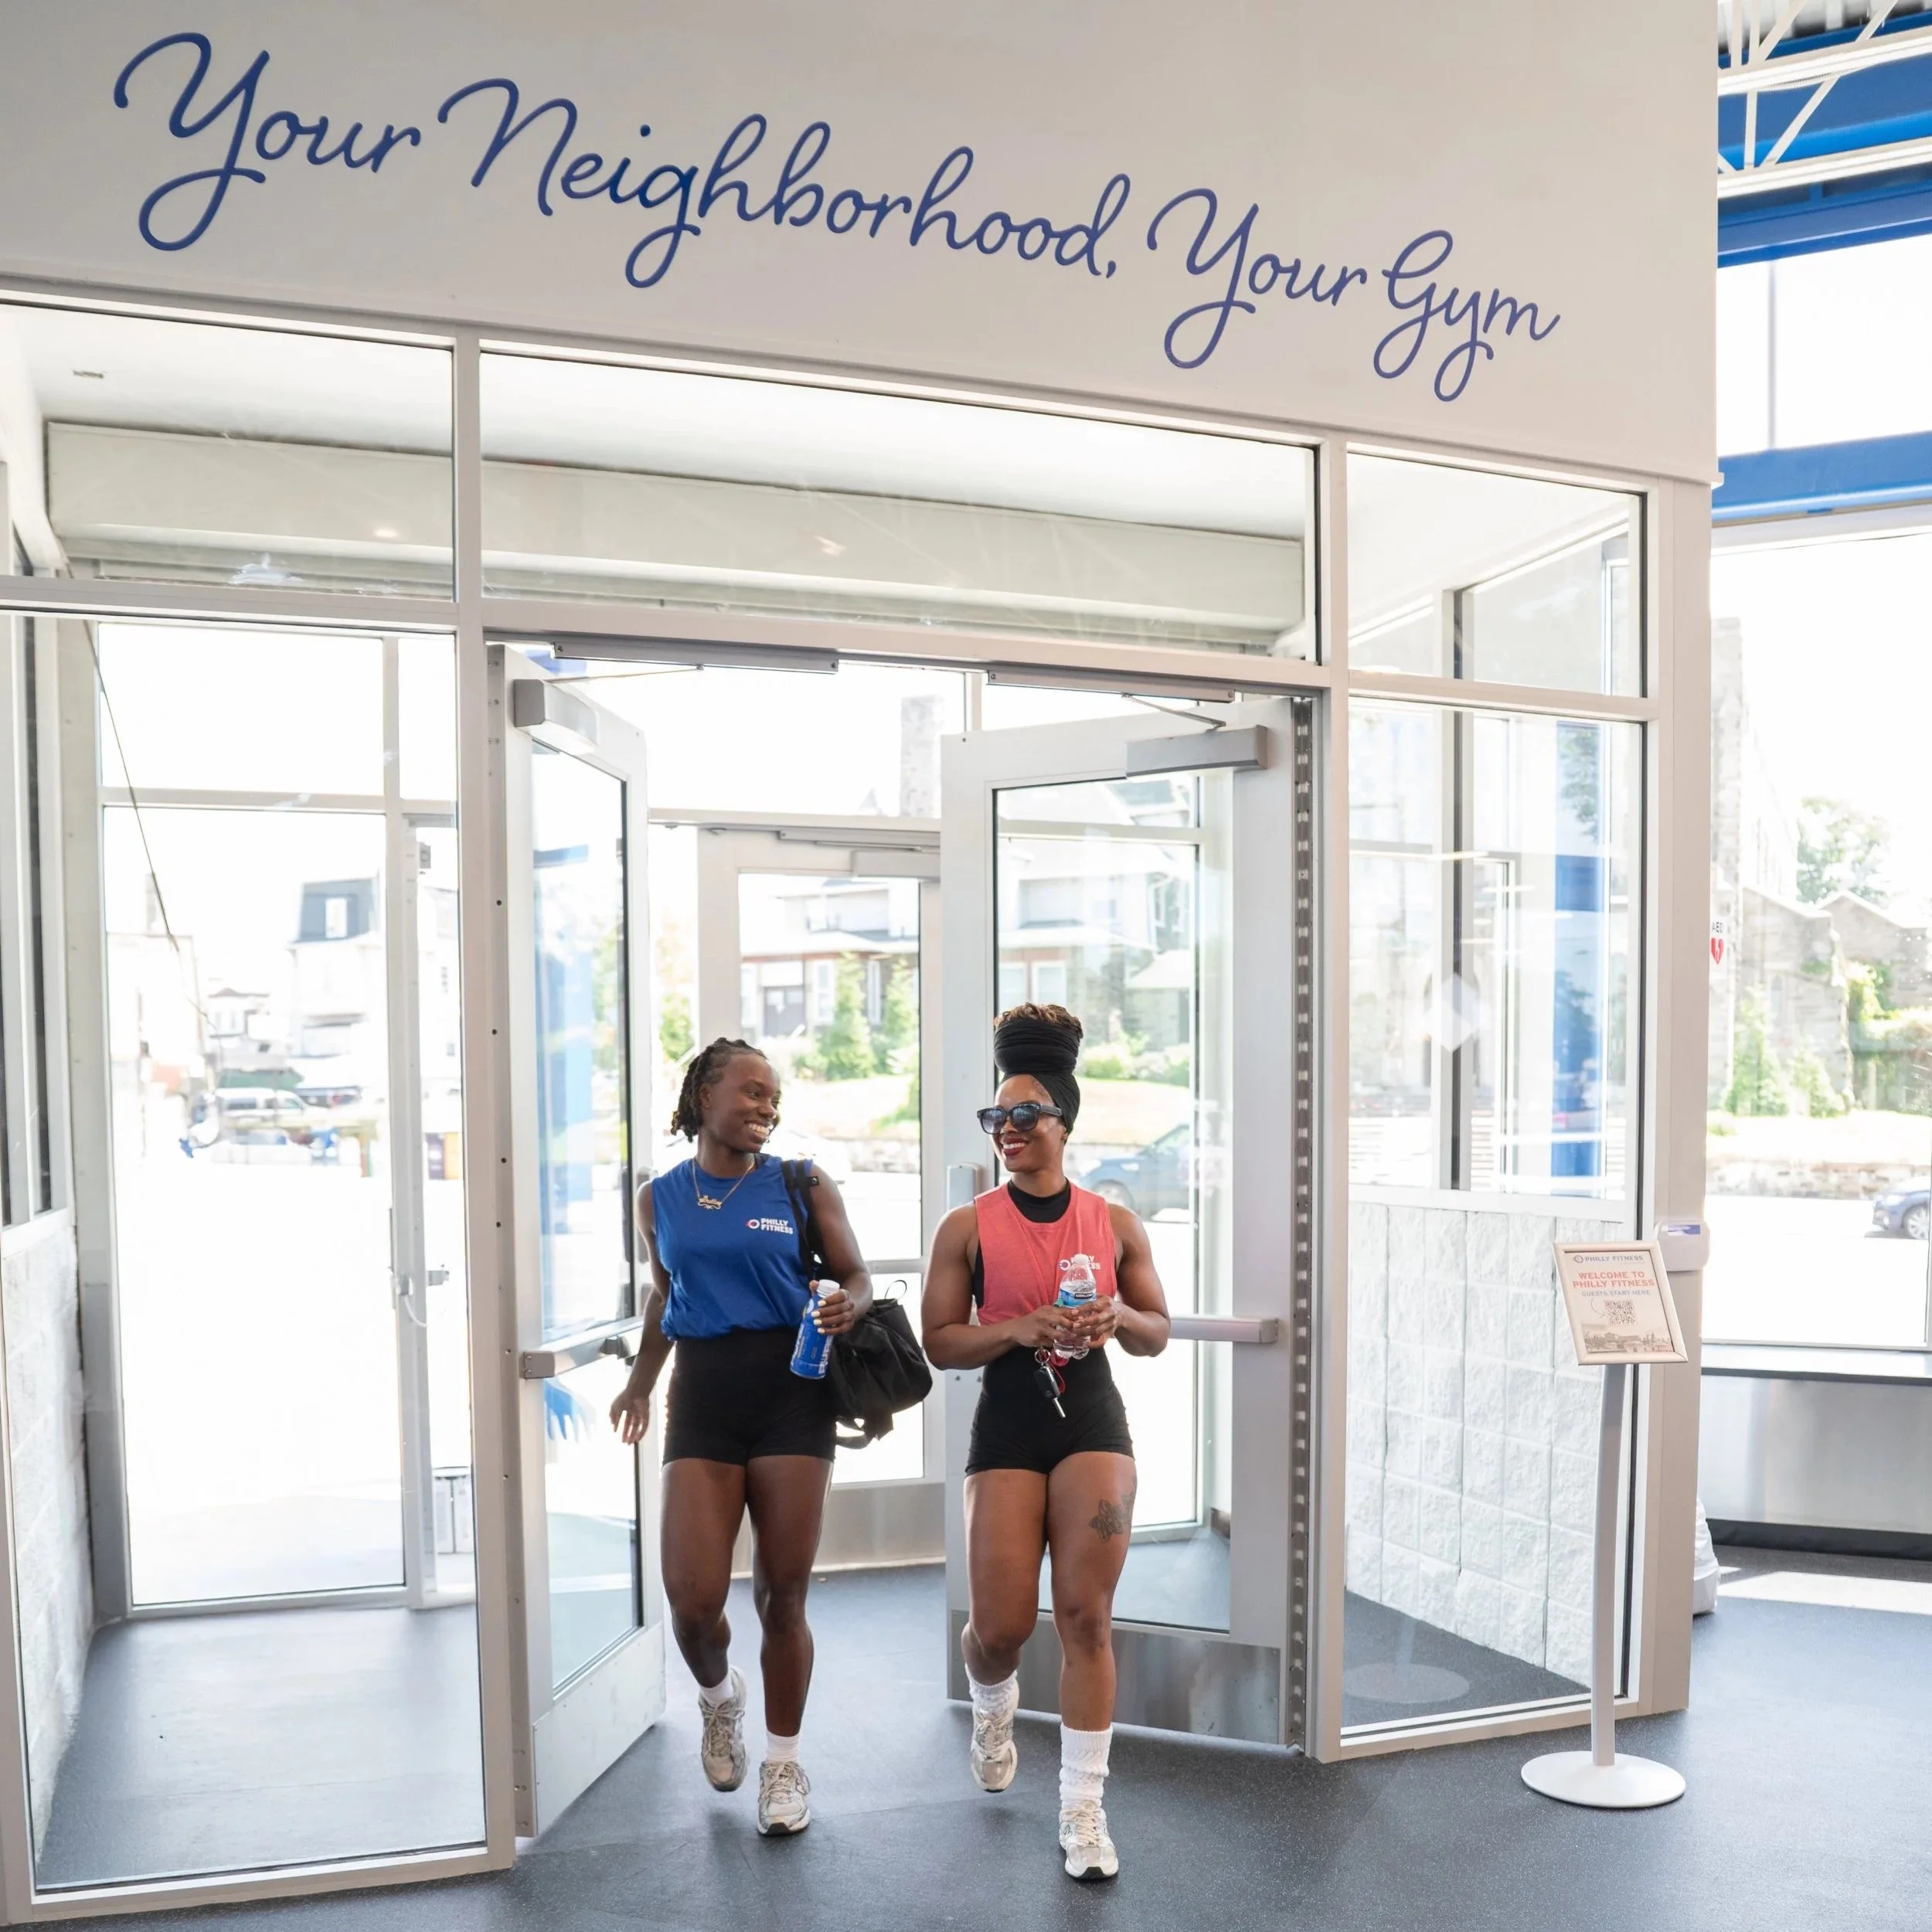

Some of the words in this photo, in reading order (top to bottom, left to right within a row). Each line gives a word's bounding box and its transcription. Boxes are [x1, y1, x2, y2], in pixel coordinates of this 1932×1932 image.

[113, 32, 422, 251] Your
[437, 77, 1131, 288] Neighborhood,
[1146, 187, 1368, 369] Your
[1372, 229, 1561, 402] Gym
[760, 1218, 788, 1226] PHILLY
[760, 1224, 794, 1234] FITNESS
[1611, 1279, 1655, 1287] FITNESS
